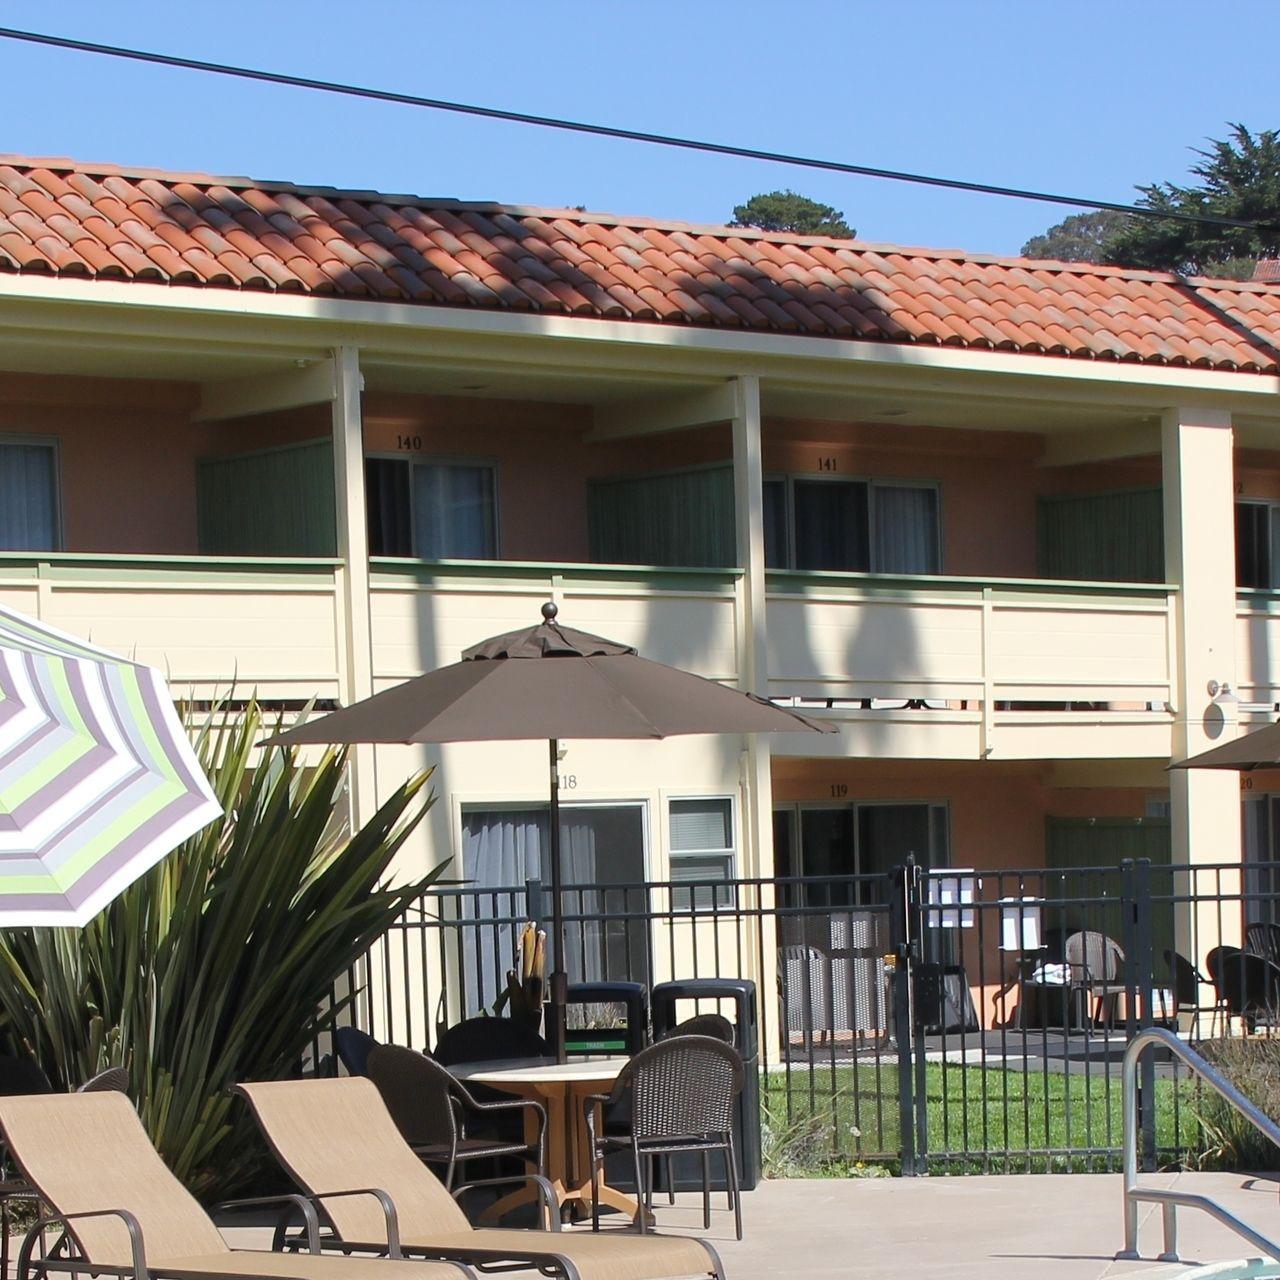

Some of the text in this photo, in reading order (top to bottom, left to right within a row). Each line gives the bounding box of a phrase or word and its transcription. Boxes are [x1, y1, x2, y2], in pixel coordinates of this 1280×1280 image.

[397, 435, 422, 450] 140
[818, 457, 837, 471] 141
[830, 784, 848, 798] 119
